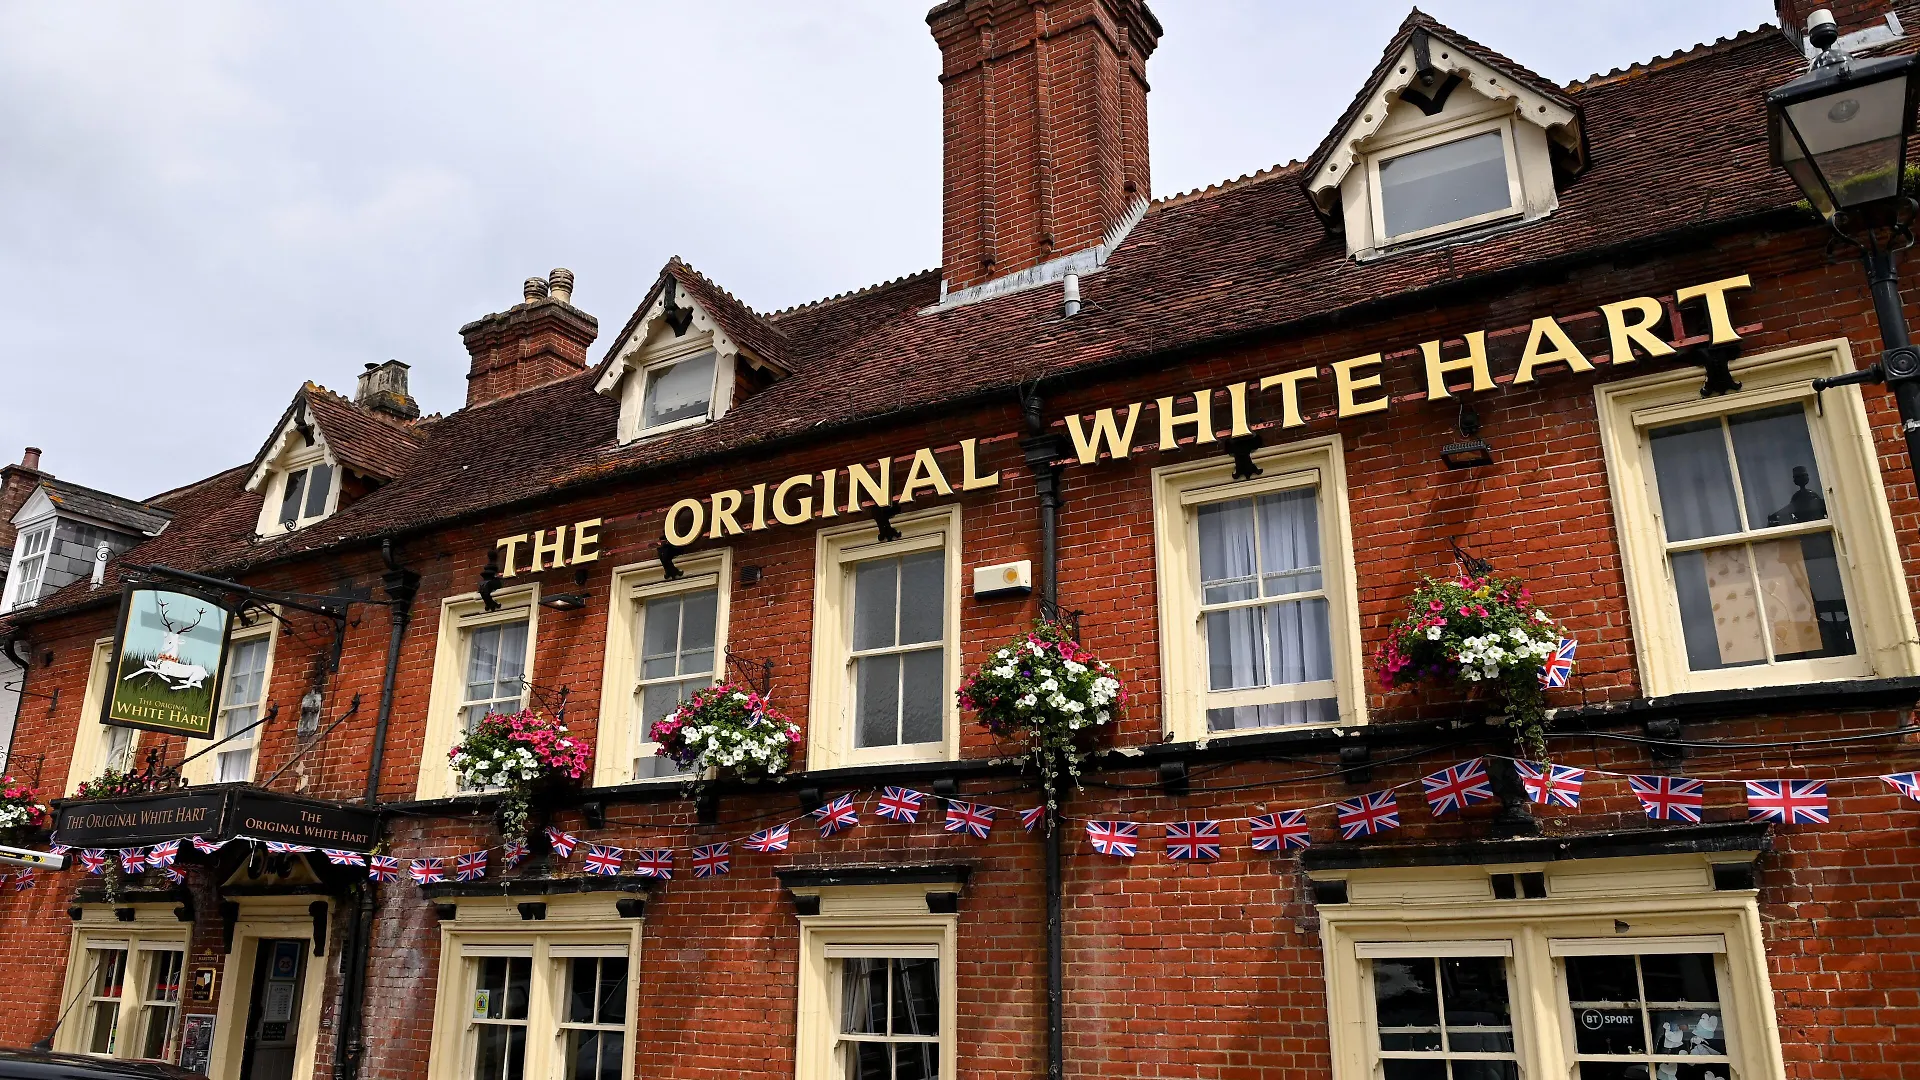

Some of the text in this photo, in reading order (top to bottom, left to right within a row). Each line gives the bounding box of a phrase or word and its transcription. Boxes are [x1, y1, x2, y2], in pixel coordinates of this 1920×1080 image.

[495, 273, 1752, 579] THE ORIGINAL WHITE HART
[116, 701, 207, 726] WHITE HART
[139, 698, 188, 712] THE ORIGINAL
[66, 806, 208, 830] THE ORIGINAL WHITE HART
[300, 810, 322, 823] THE
[245, 817, 369, 844] ORIGINAL WHITE HART
[1586, 1015, 1634, 1024] BT SPORT
